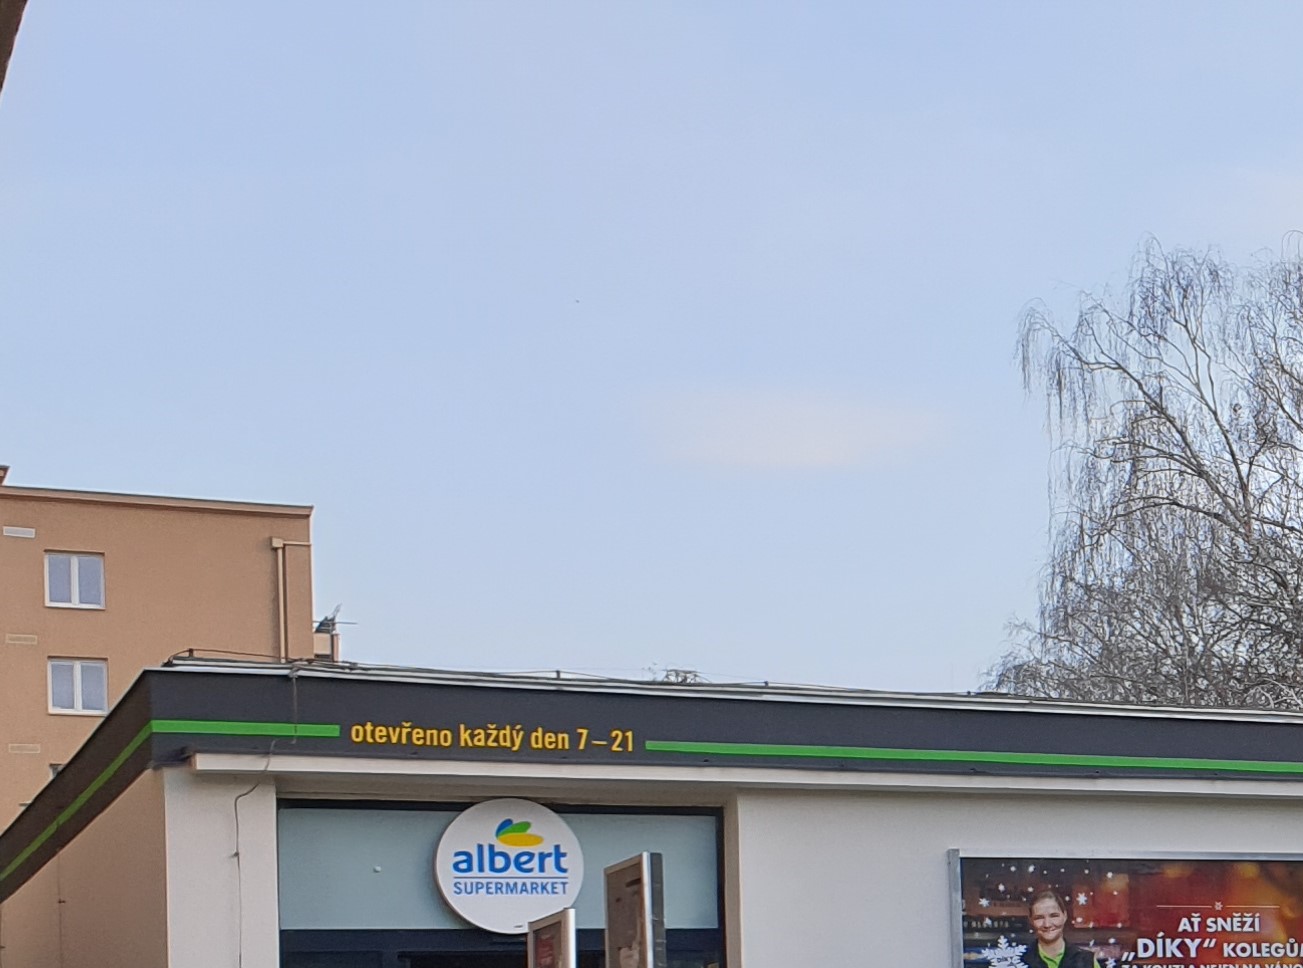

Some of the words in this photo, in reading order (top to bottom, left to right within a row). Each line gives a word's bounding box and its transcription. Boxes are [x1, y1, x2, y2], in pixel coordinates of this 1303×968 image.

[350, 721, 452, 747] otevřeno
[459, 723, 524, 751] každý
[530, 727, 570, 750] den
[452, 843, 569, 874] albert
[453, 881, 569, 895] SUPERMARKET
[1177, 912, 1202, 933] AŤ
[1205, 911, 1261, 933] SNĚŽÍ
